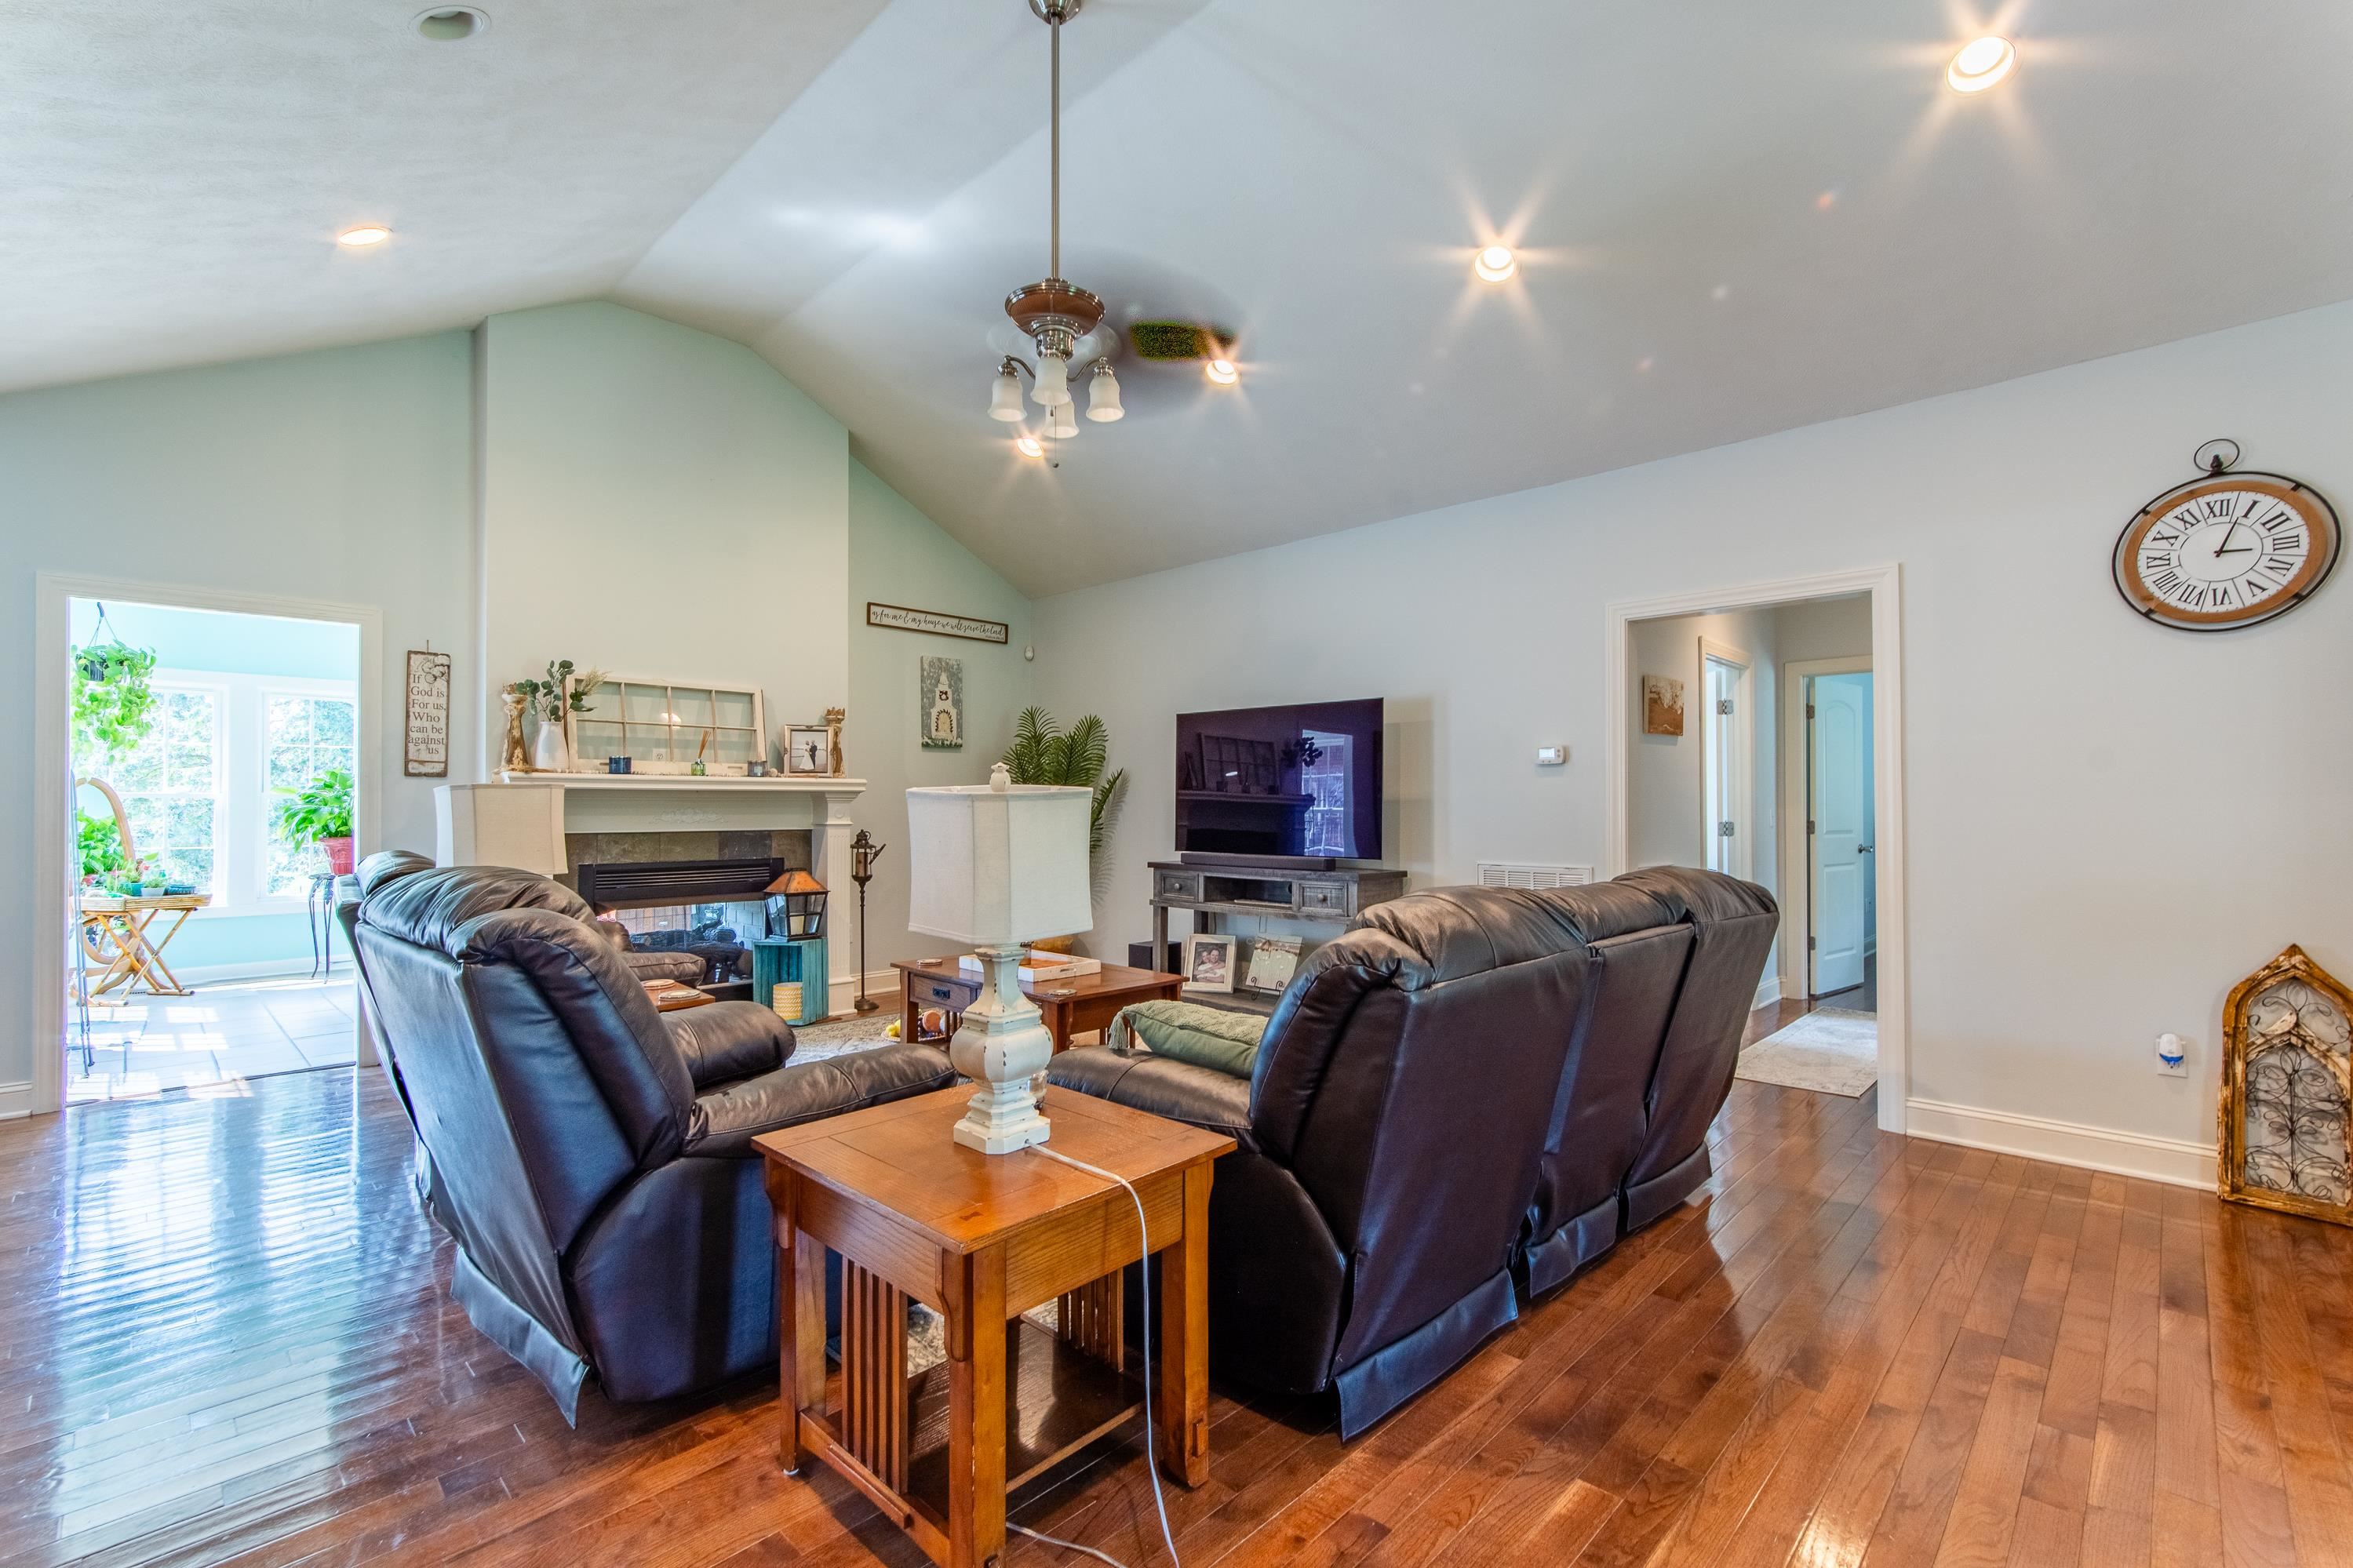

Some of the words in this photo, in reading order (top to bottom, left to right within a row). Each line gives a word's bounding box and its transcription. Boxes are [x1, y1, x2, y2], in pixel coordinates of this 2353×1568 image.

[2205, 498, 2231, 519] XII
[2240, 499, 2261, 519] I
[2173, 508, 2202, 531] XI
[2260, 511, 2293, 533] II
[2151, 529, 2180, 547] X
[2272, 533, 2300, 552] III
[2146, 552, 2171, 569] IX
[2264, 557, 2295, 577] IV
[2153, 571, 2183, 595] VIII
[2246, 579, 2269, 598] V
[2178, 584, 2205, 606] VII
[2212, 587, 2233, 606] VI
[879, 609, 891, 623] for
[904, 611, 910, 624] &
[911, 617, 922, 628] my
[413, 674, 422, 683] If
[410, 686, 433, 697] God
[436, 687, 445, 697] is
[412, 699, 429, 709] For
[413, 711, 440, 722] Who
[432, 724, 443, 734] be
[408, 734, 445, 746] against
